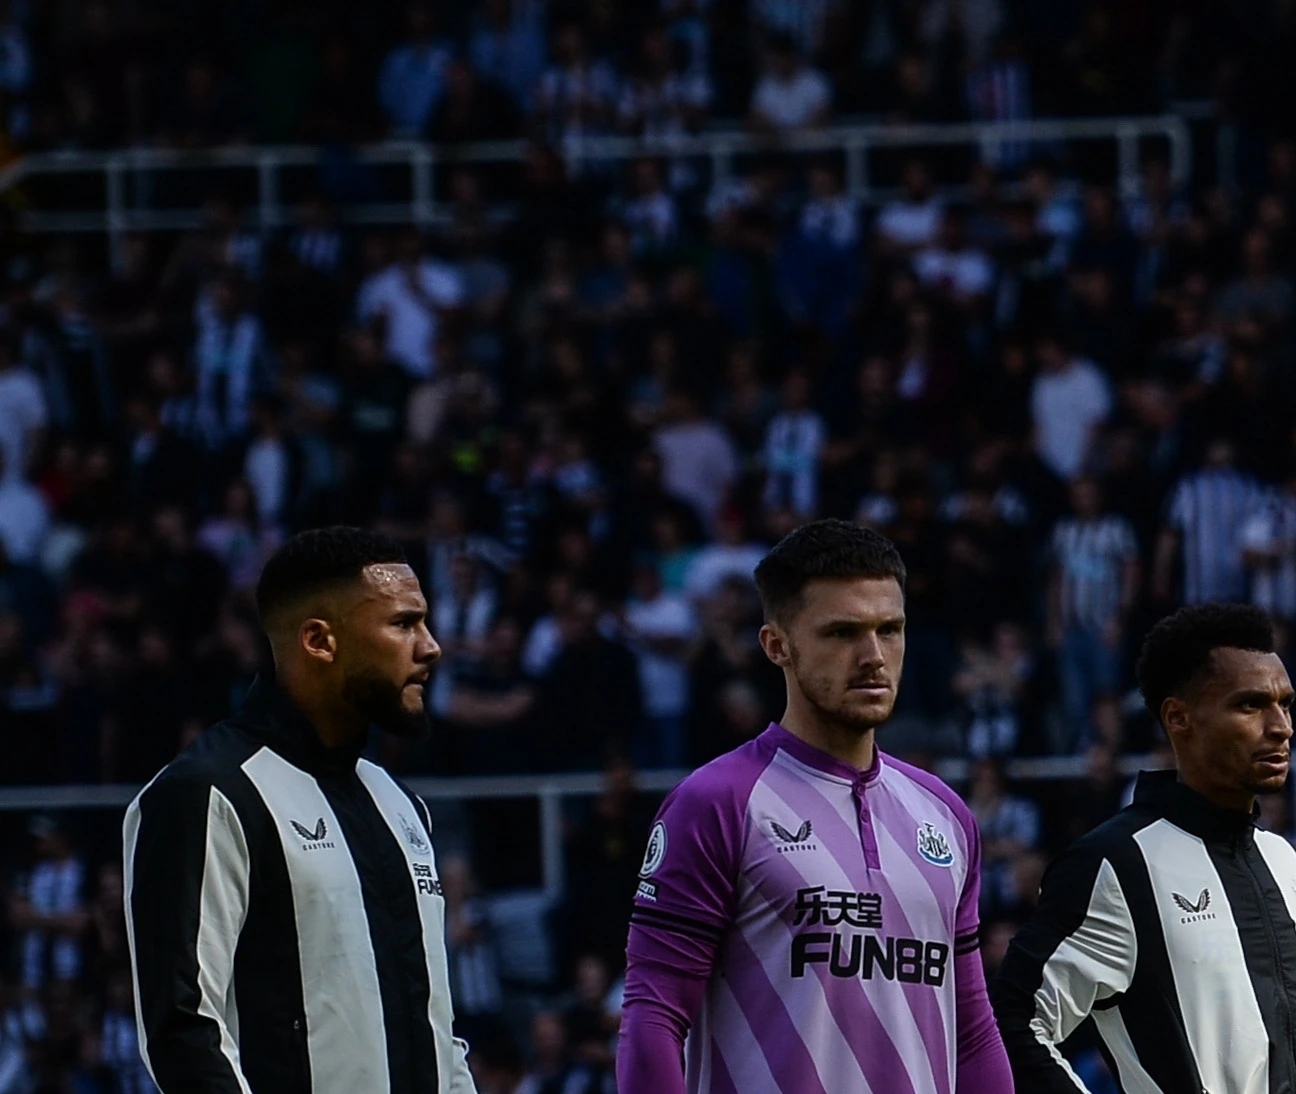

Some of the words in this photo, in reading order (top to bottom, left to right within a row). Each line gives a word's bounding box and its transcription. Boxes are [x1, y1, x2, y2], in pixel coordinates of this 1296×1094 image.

[302, 841, 336, 851] CASTORE
[777, 844, 817, 853] CASTORE
[793, 886, 882, 929] 乐天堂
[1180, 913, 1216, 924] CASTORE
[790, 933, 949, 987] FUN88
